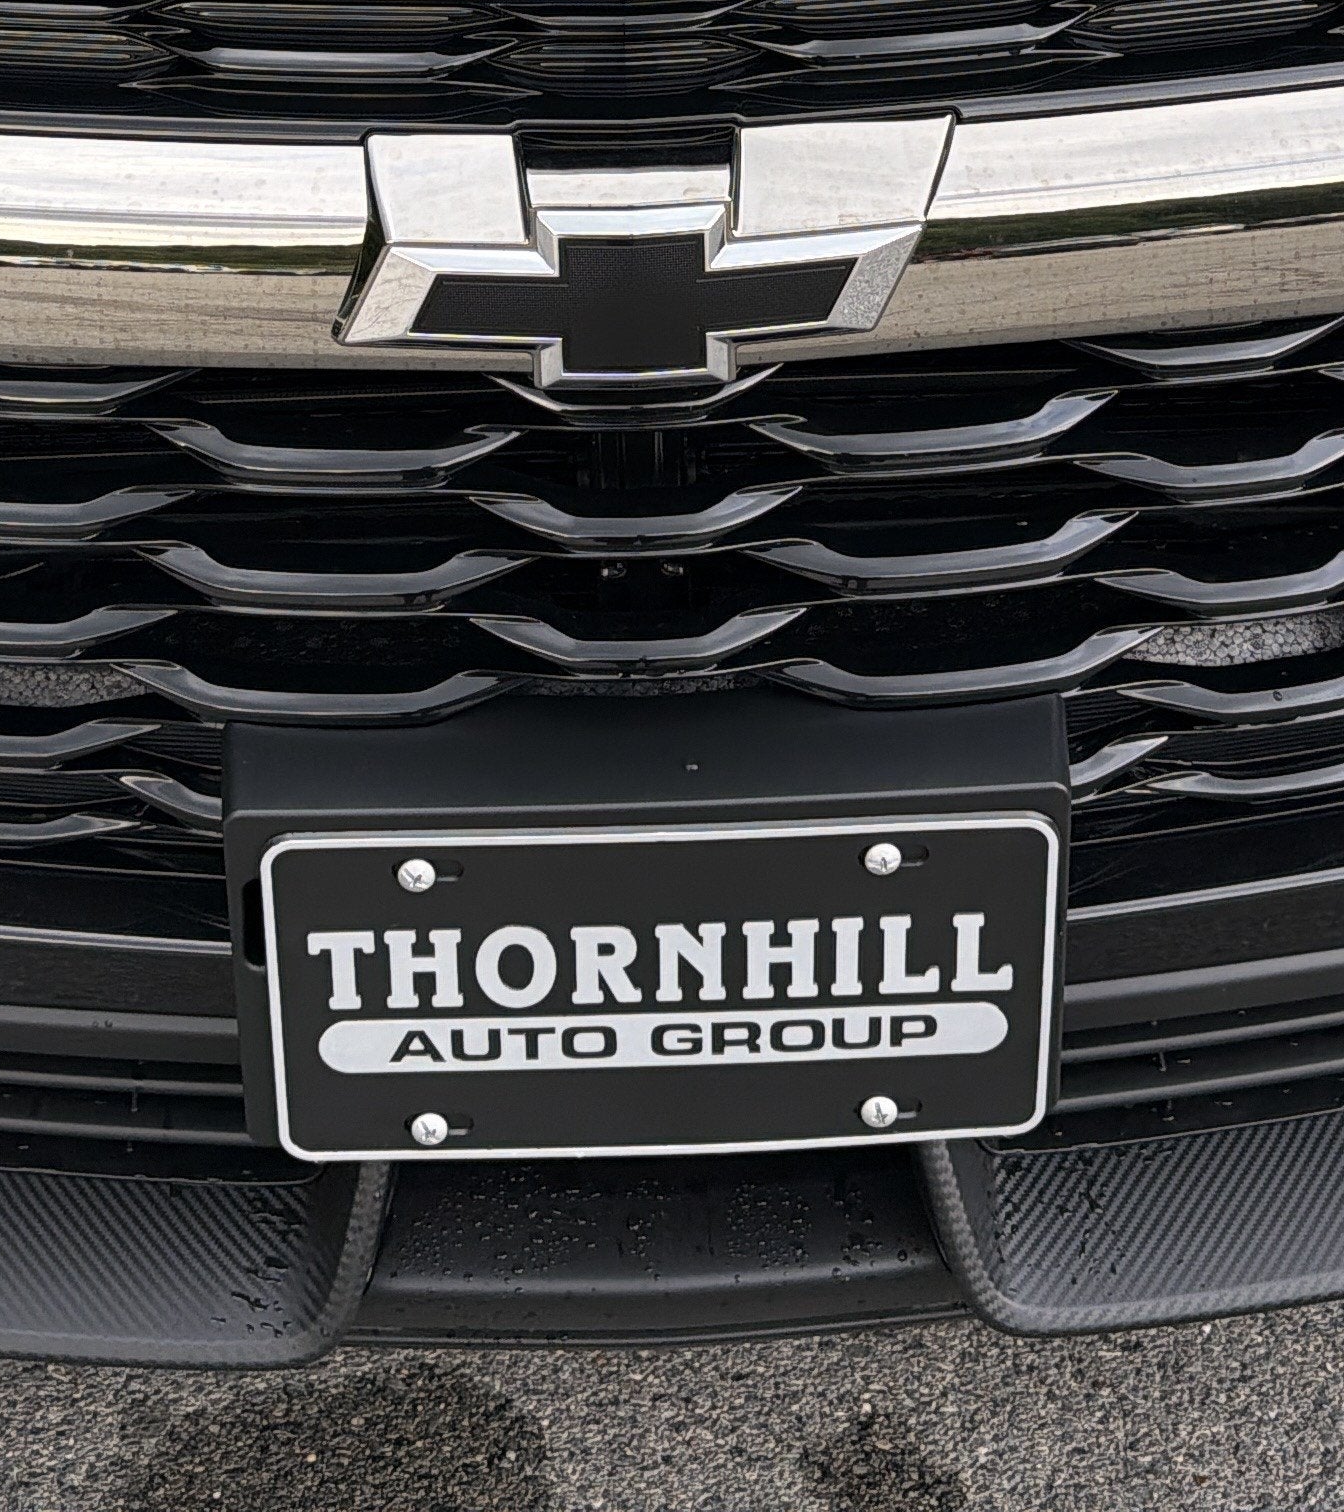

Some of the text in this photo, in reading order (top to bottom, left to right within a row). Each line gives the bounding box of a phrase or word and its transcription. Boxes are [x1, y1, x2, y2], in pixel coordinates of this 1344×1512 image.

[307, 913, 1013, 1009] THORNHILL
[389, 1015, 938, 1064] AUTO GROUP
